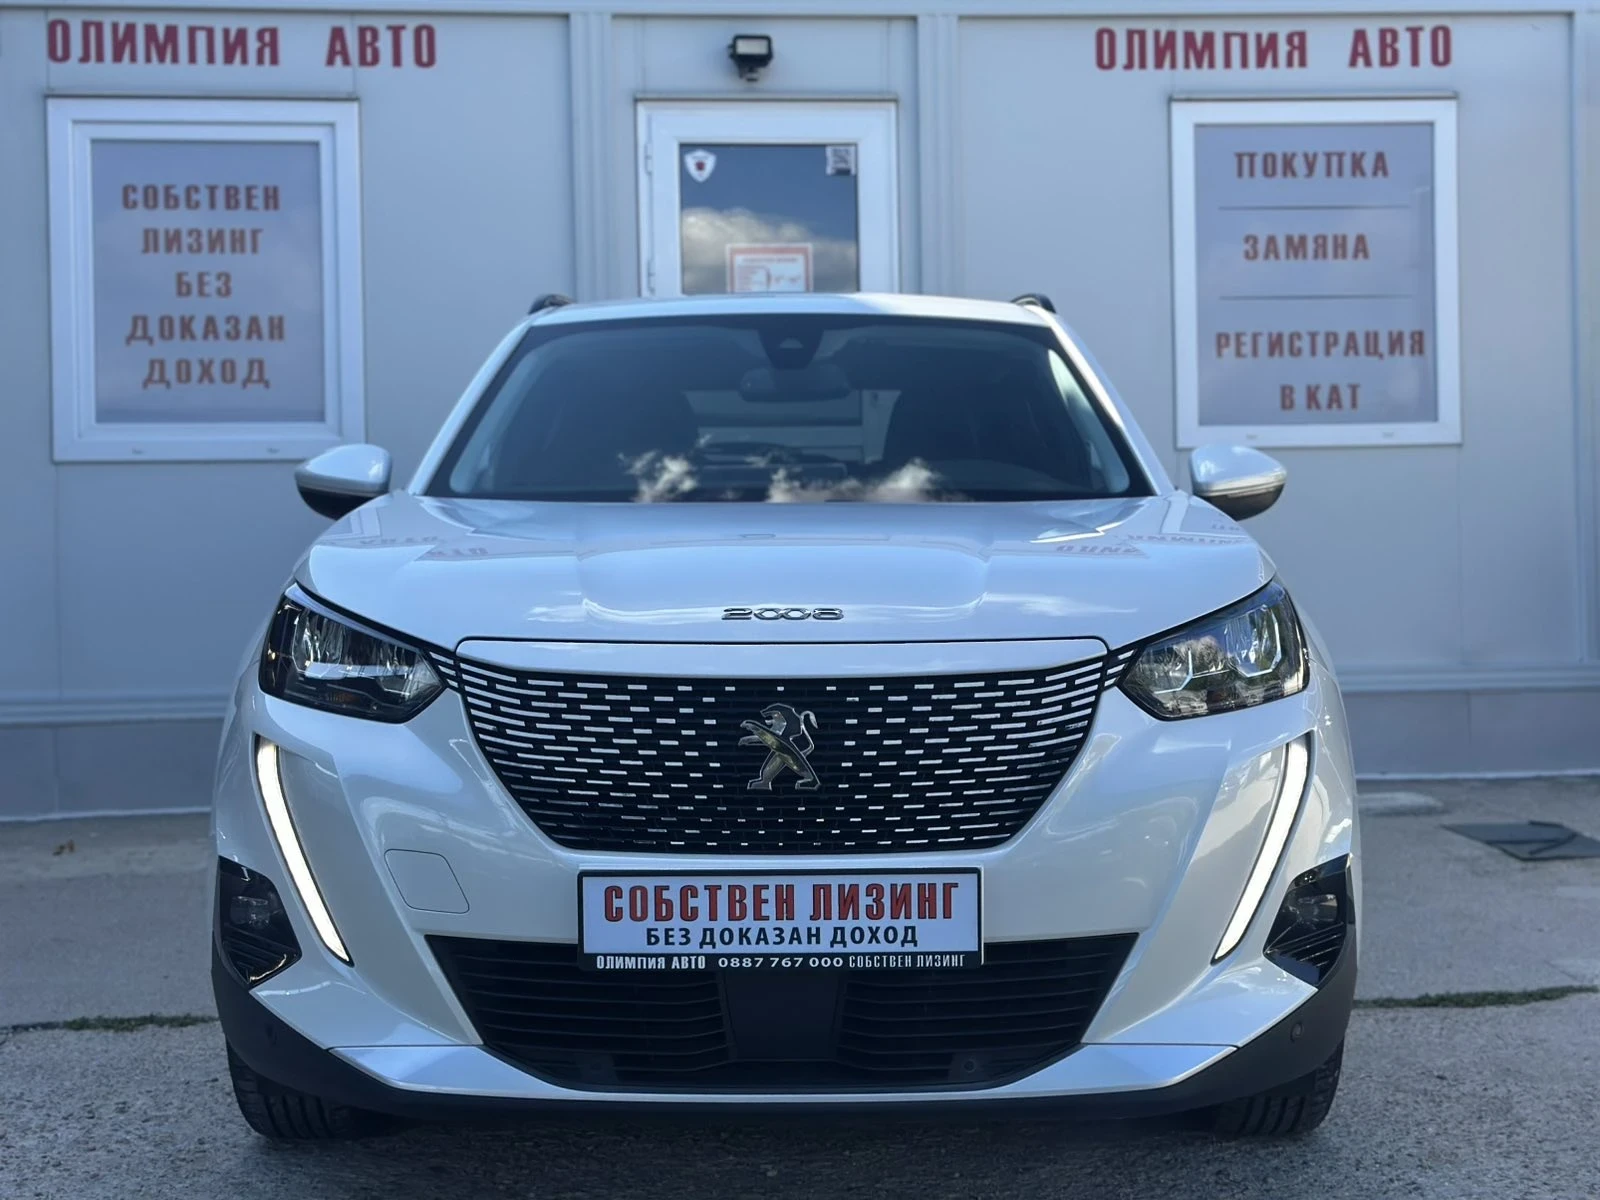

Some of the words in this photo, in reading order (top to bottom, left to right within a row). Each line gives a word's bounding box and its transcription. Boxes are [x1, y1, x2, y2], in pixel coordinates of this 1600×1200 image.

[47, 19, 280, 66] ОЛИМПИЯ
[325, 23, 437, 69] АВТО
[1095, 27, 1308, 71] ОЛИМПИЯ
[1349, 25, 1452, 68] АВТО
[1235, 151, 1390, 179] ПОКУПКА
[121, 184, 281, 212] СОБСТВЕН
[141, 228, 264, 255] ЛИЗИНГ
[1243, 233, 1371, 261] ЗАМЯНА
[175, 271, 233, 299] БЕЗ
[125, 315, 285, 347] ДОКАЗАН
[1215, 330, 1425, 360] РЕГИСТРАЦИЯ
[142, 358, 271, 390] ДОХОД
[1280, 384, 1296, 411] В
[1306, 383, 1361, 411] КАТ
[721, 607, 844, 621] 2008
[604, 884, 795, 922] СОБСТВЕН
[809, 882, 960, 921] ЛИЗИНГ
[645, 927, 692, 947] БЕЗ
[699, 926, 821, 949] ДОКАЗАН
[830, 925, 919, 948] ДОХОД
[596, 955, 666, 970] ОЛИМПИЯ
[671, 955, 706, 970] АВТО
[717, 957, 764, 968] 0887
[769, 957, 803, 968] 767
[808, 957, 844, 968] 000
[848, 955, 913, 969] СОБСТВЕН
[916, 954, 965, 969] ЛИЗИНГ
